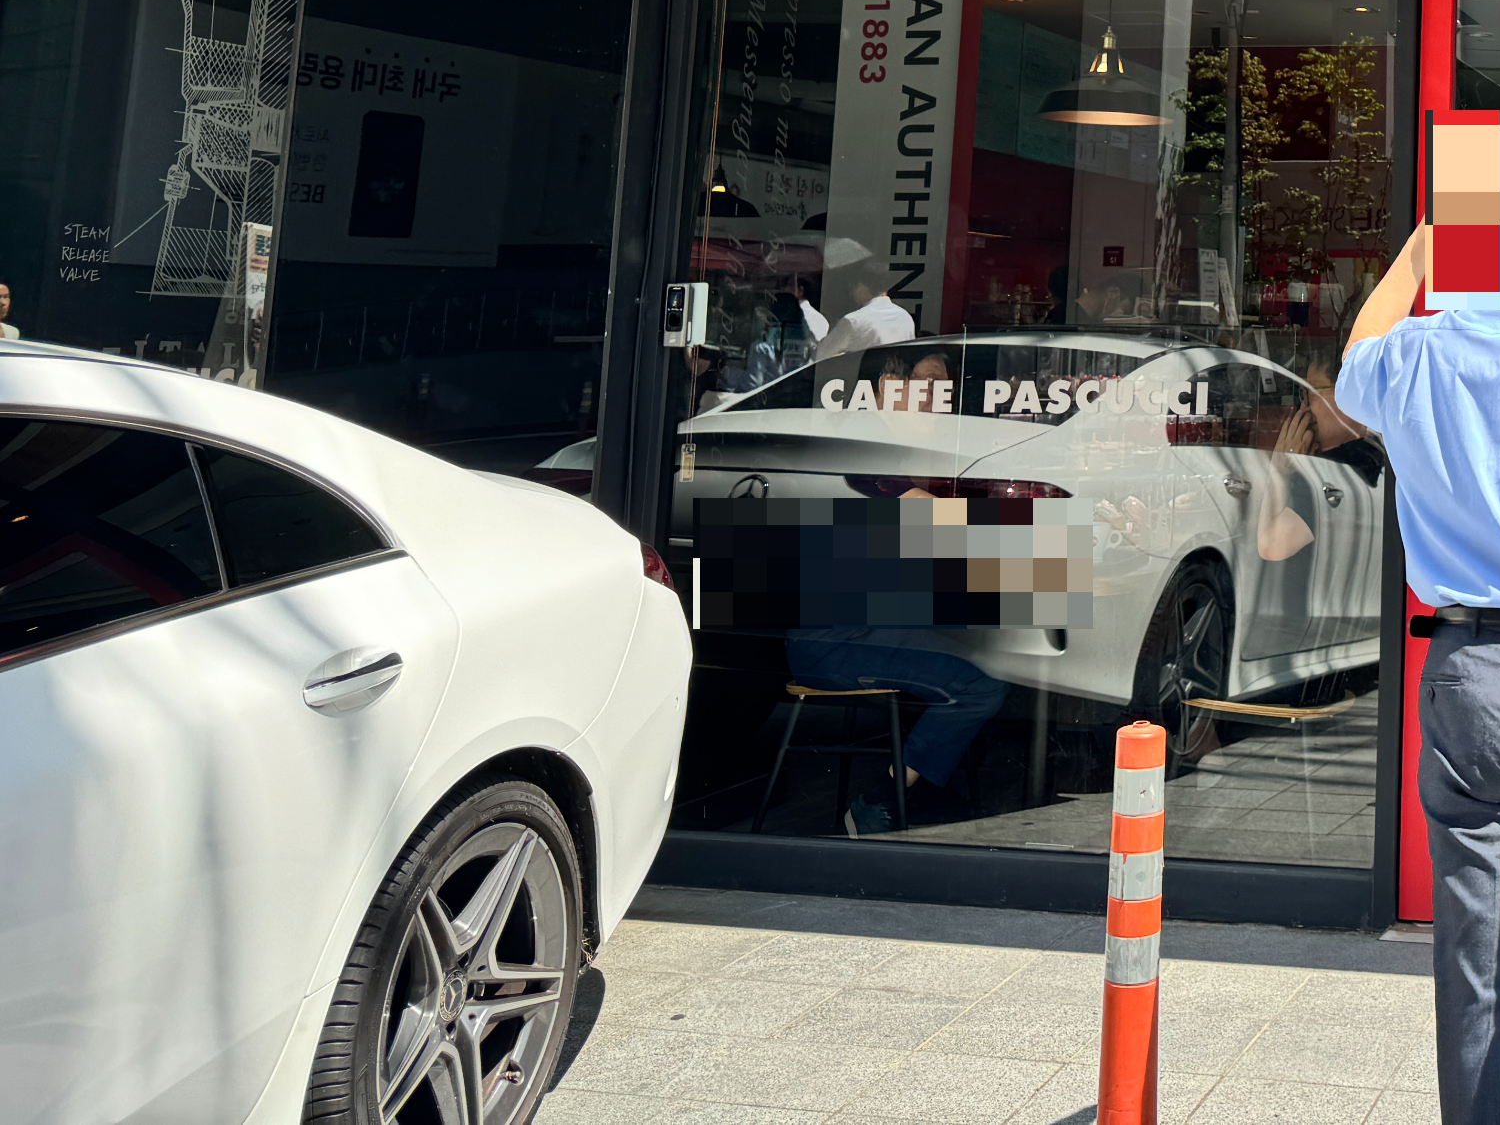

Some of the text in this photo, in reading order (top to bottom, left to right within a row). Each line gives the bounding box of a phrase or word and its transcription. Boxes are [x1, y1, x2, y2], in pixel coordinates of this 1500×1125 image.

[859, 0, 891, 84] 1883
[64, 223, 110, 243] STEAM
[61, 246, 110, 263] RELEASE
[60, 266, 101, 282] VALVE
[820, 378, 1209, 415] CAFFE PASCUCCI
